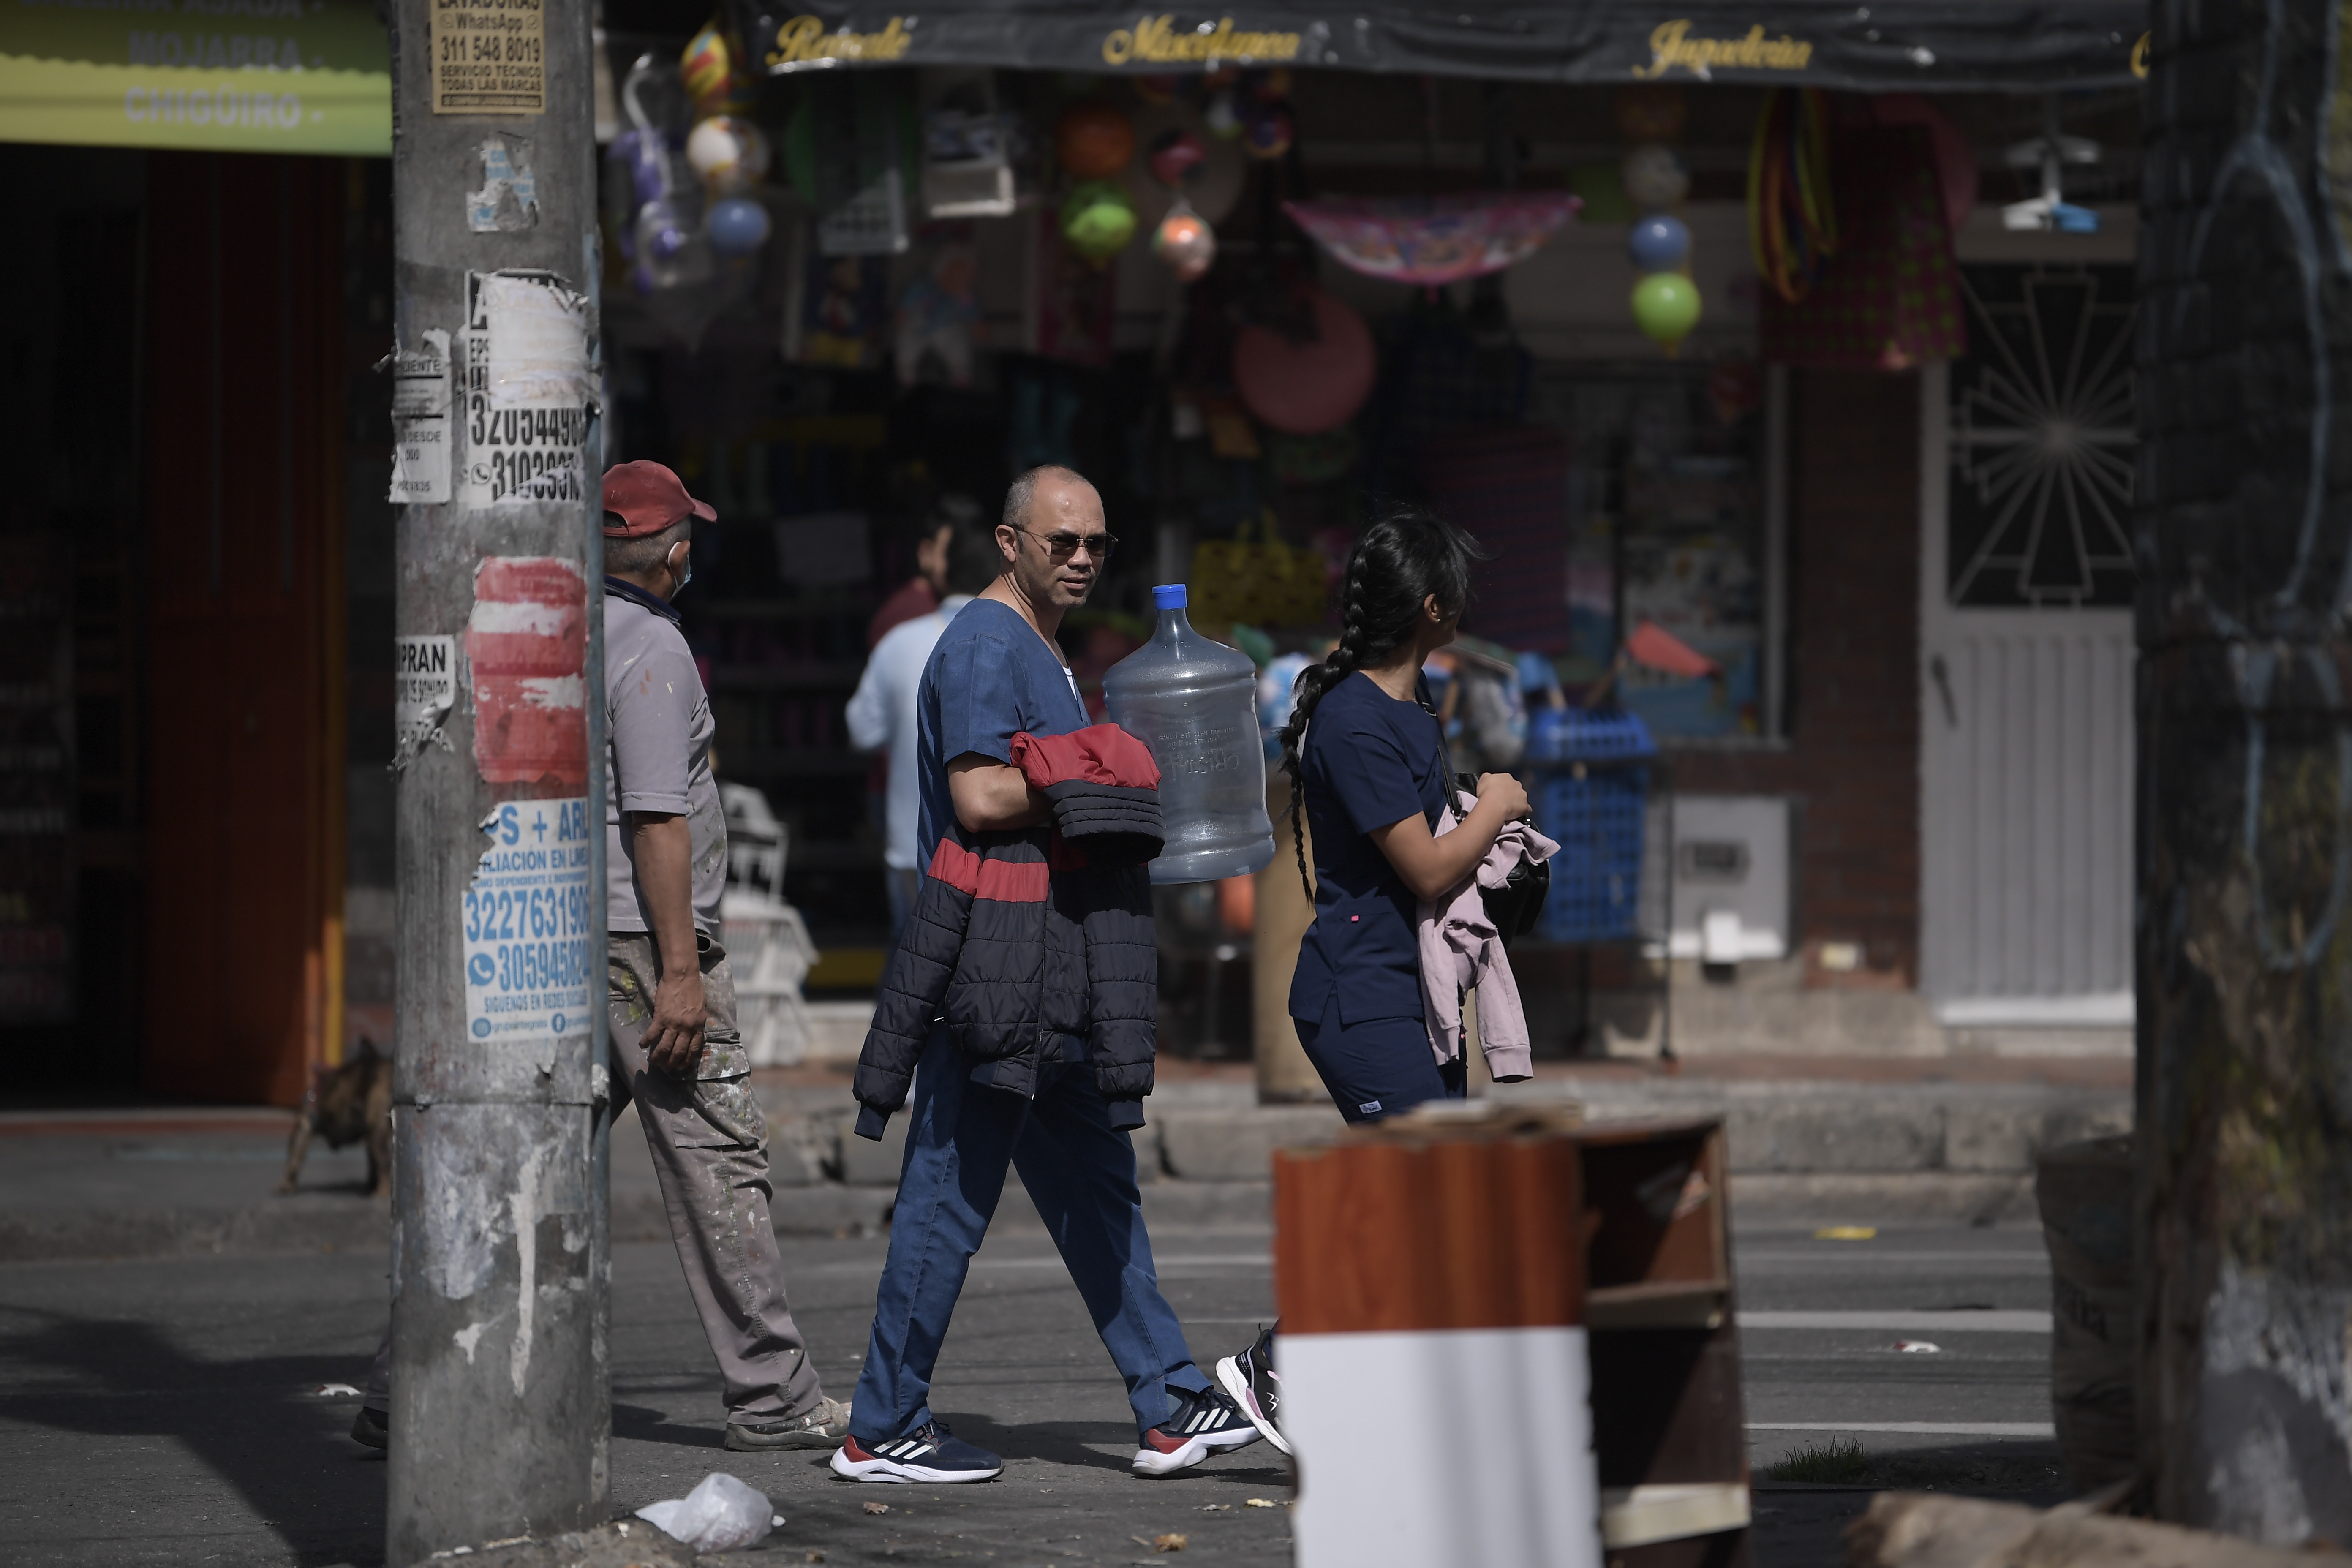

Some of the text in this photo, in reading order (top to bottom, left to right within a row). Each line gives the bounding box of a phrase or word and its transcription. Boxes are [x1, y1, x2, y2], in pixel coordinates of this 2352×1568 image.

[456, 13, 522, 34] WhatsApp
[128, 30, 303, 73] MOJARRA
[441, 35, 540, 62] 311 548 8019
[441, 65, 491, 77] SERVICIO
[442, 79, 541, 91] TODAS LAS MARCAS
[125, 83, 301, 128] CHIGÜIRO
[551, 849, 566, 868] EN
[531, 994, 540, 1010] EN
